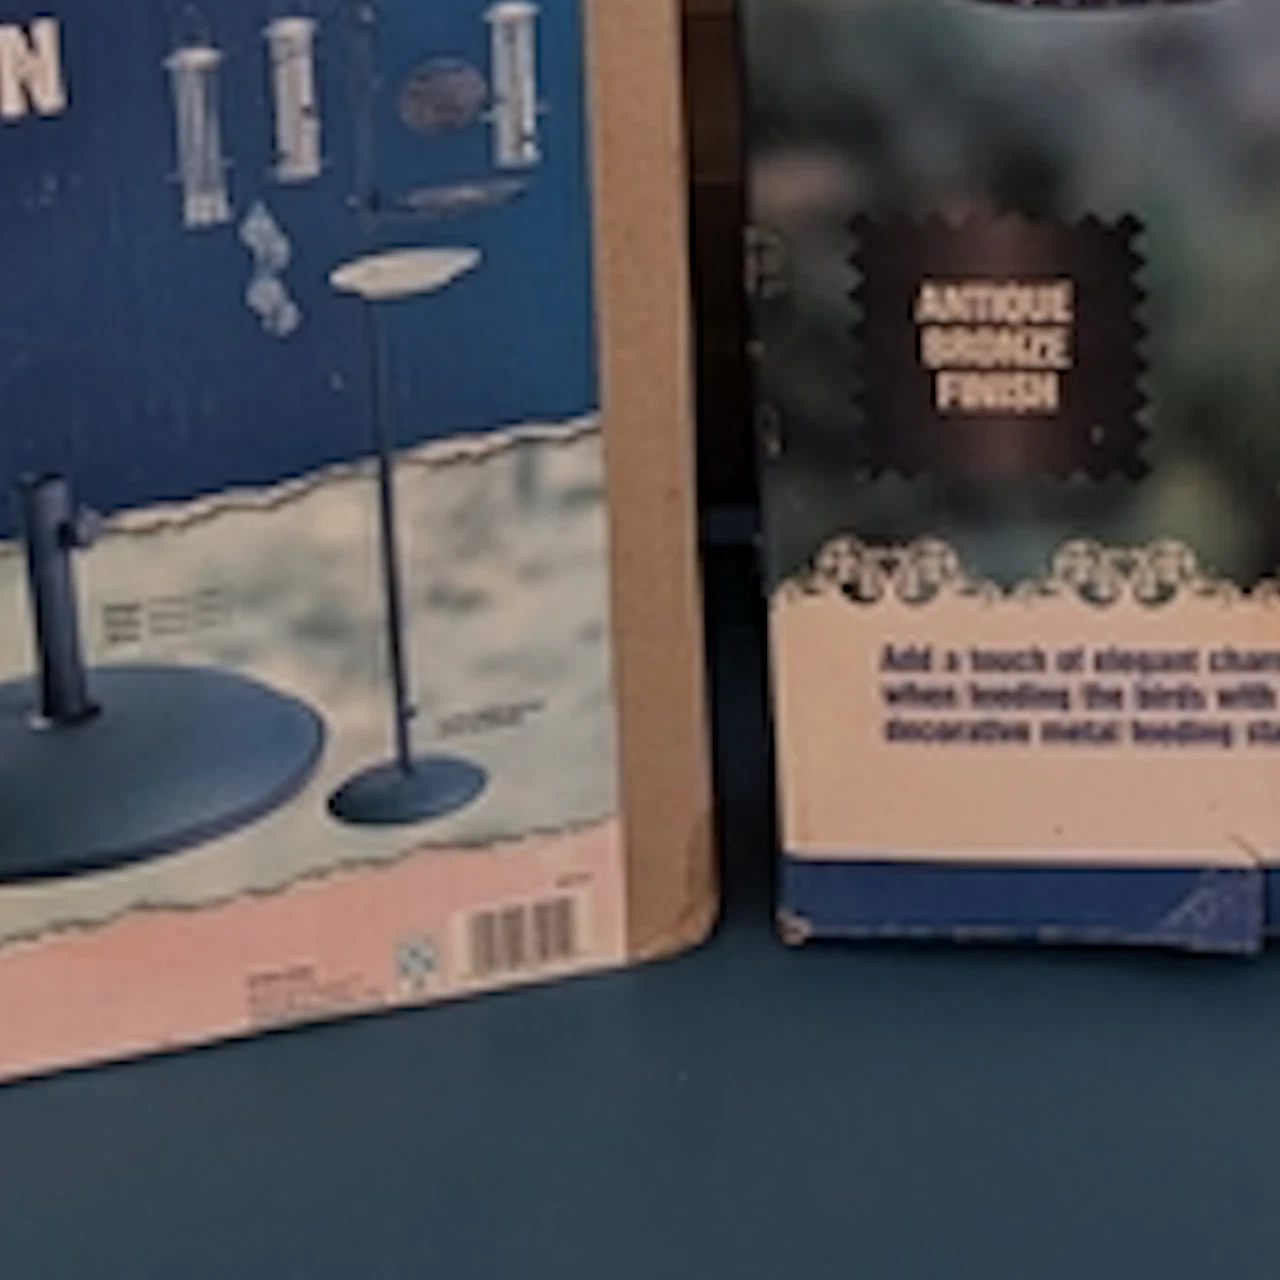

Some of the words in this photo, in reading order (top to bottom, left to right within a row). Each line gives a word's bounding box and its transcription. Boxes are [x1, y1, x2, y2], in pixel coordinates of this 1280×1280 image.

[914, 277, 1074, 324] ANTIQUE
[921, 325, 1073, 370] BRONZE
[935, 370, 1060, 414] FINISH
[880, 644, 933, 673] Add
[970, 645, 1047, 673] touch
[1055, 645, 1085, 673] of
[1094, 645, 1200, 679] elegant
[882, 681, 958, 709] when
[970, 680, 1072, 713] feeding
[1083, 681, 1124, 710] the
[1137, 680, 1208, 710] birds
[1217, 680, 1277, 710] with
[884, 718, 1031, 744] decorative
[1040, 718, 1119, 744] metal
[1132, 718, 1234, 750] feeding
